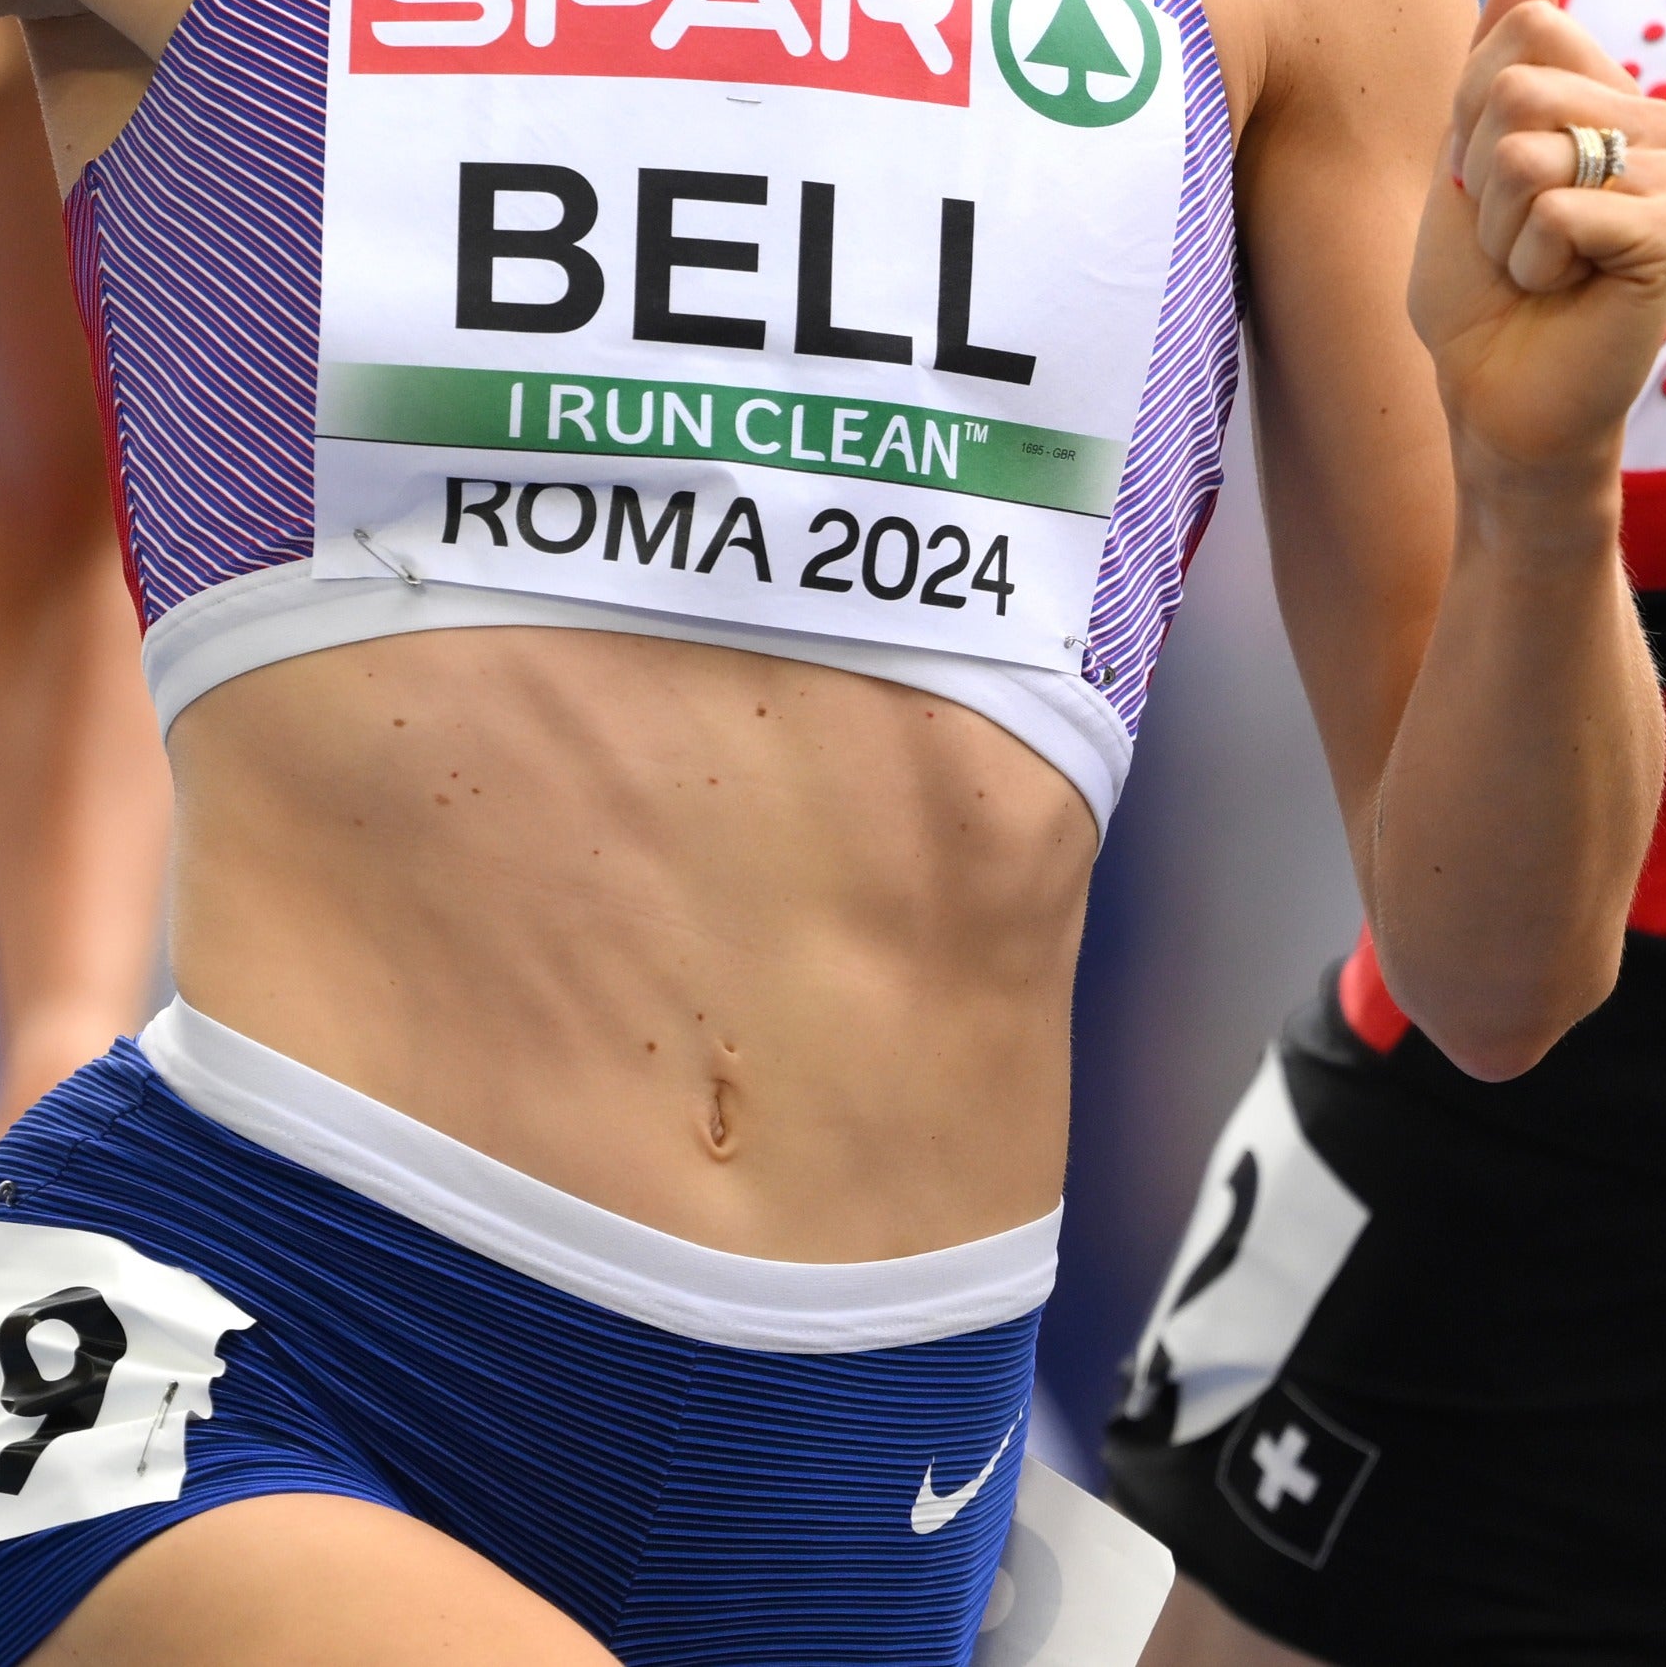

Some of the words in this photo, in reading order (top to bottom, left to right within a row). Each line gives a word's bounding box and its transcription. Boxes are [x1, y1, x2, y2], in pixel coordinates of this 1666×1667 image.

[453, 160, 1039, 388] BELL
[507, 381, 525, 442] I
[547, 382, 714, 450] RUN
[1021, 441, 1044, 457] 1695
[1052, 446, 1077, 462] GBR
[440, 476, 774, 585] ROMA
[799, 508, 1017, 618] 2024
